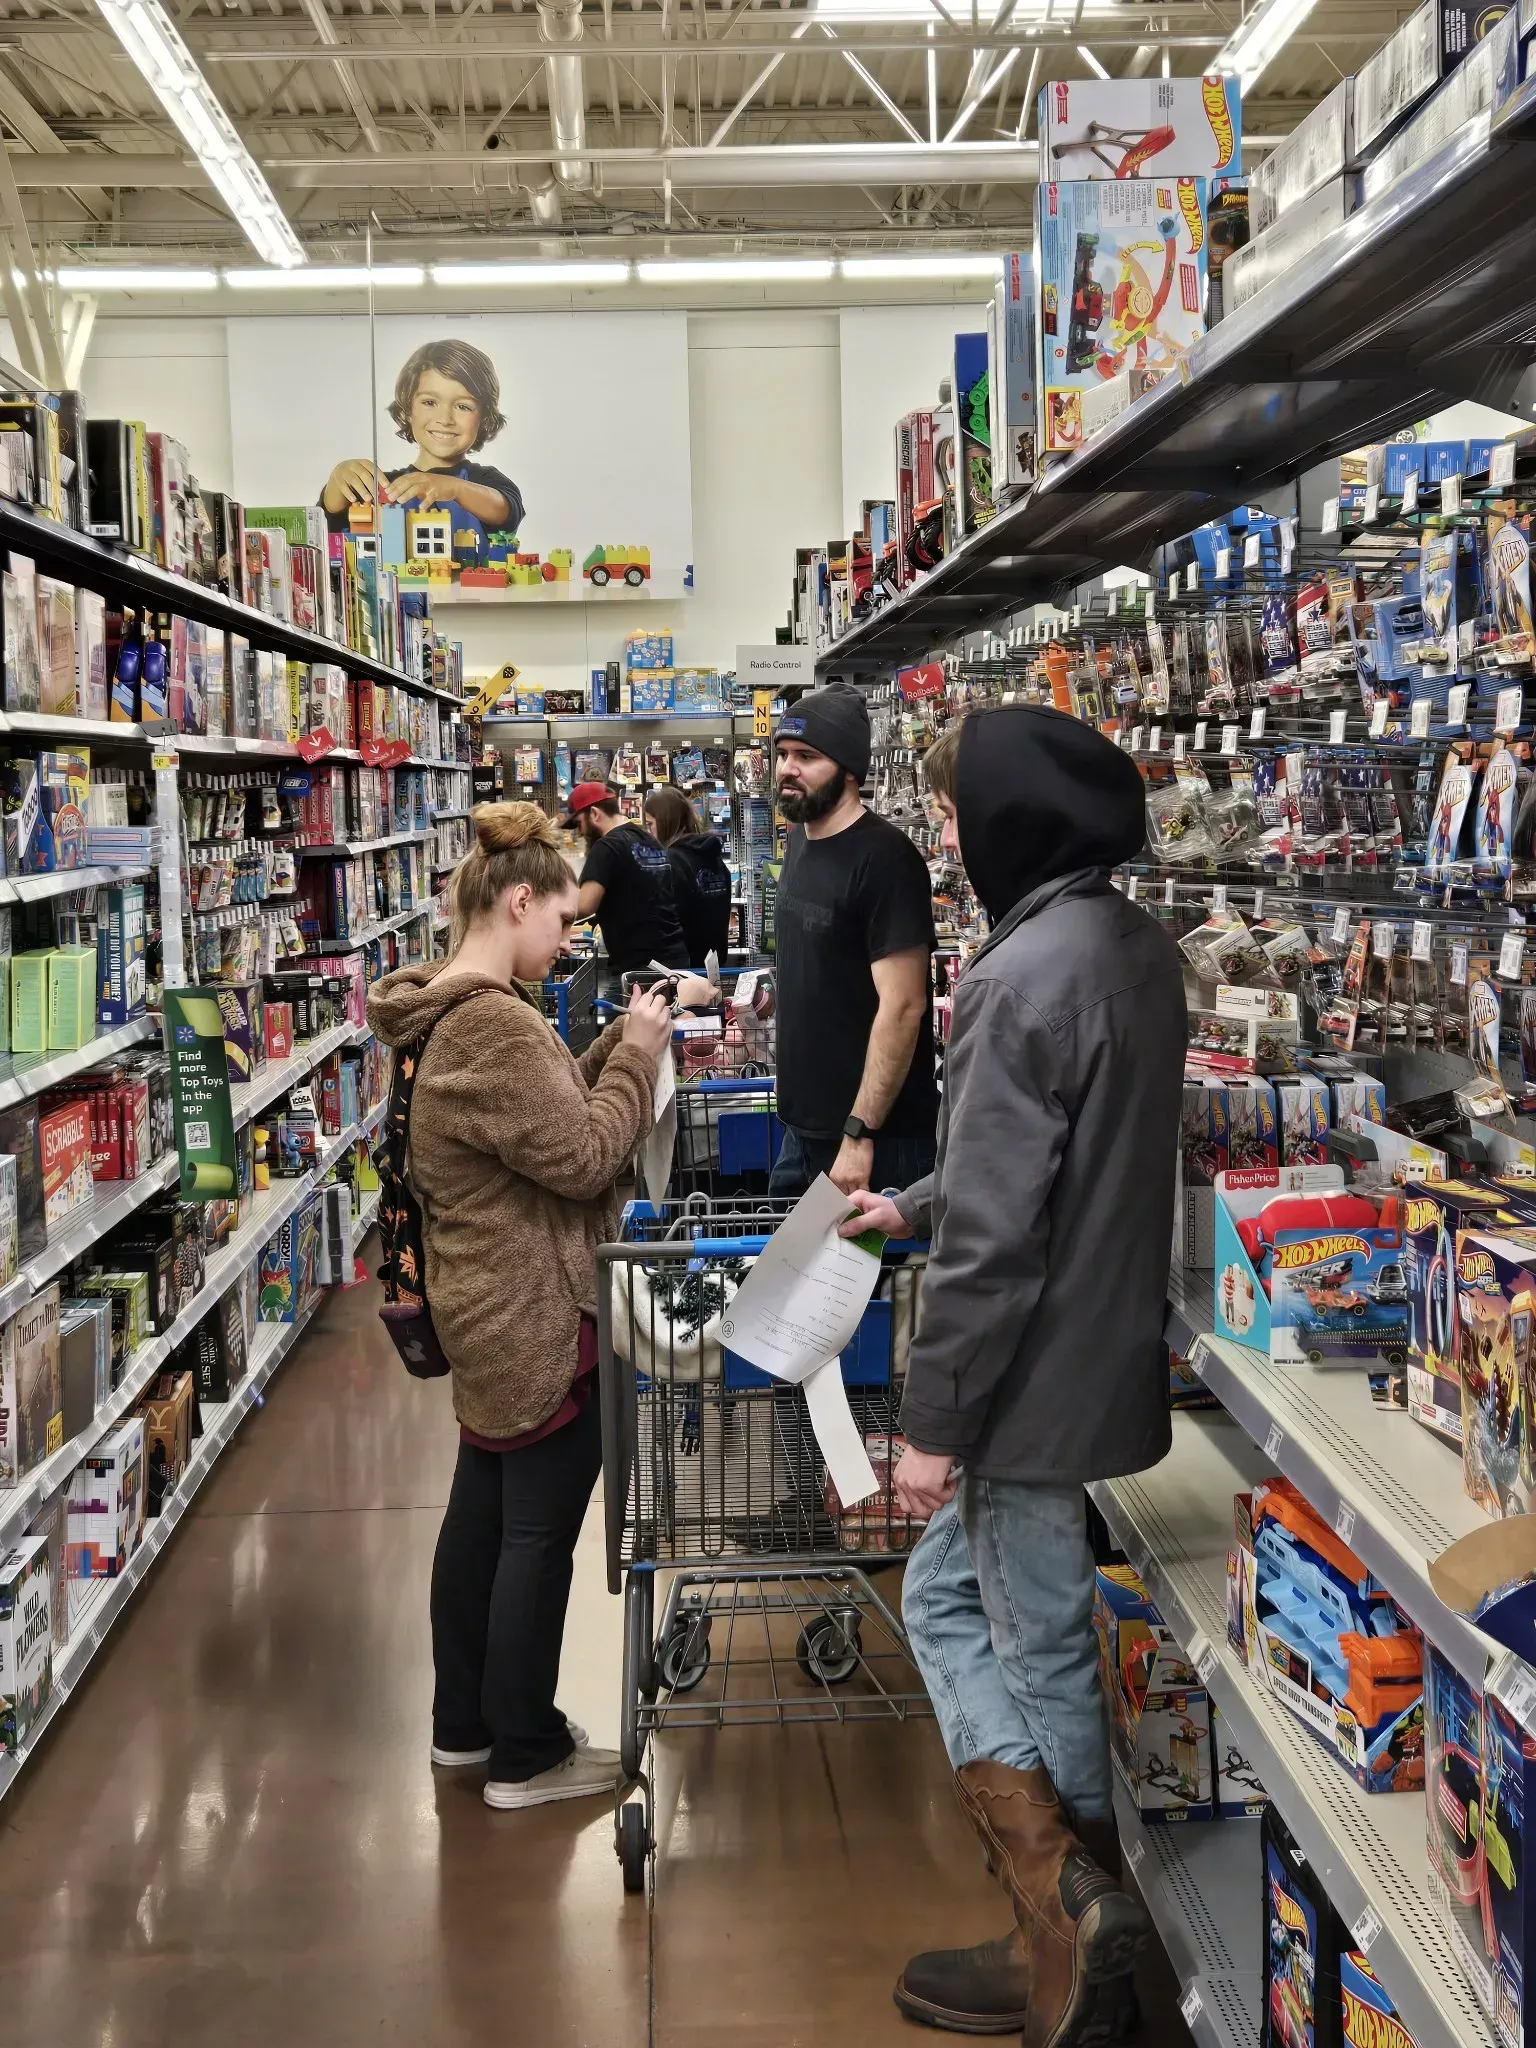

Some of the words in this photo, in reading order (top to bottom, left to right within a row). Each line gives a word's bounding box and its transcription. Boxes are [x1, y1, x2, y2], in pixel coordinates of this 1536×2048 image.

[902, 429, 910, 466] NASCAR
[750, 660, 772, 669] Radio
[773, 660, 802, 669] Control
[478, 691, 492, 707] N
[906, 685, 940, 700] Rollback
[757, 706, 767, 718] N
[756, 722, 767, 734] 10
[109, 911, 120, 938] WHAT
[110, 940, 120, 951] DO
[110, 952, 121, 972] YOU
[111, 972, 122, 1002] MEME?
[178, 1050, 201, 1061] Find
[179, 1064, 207, 1072] more
[180, 1077, 200, 1089] Top
[201, 1076, 224, 1088] Toys
[182, 1091, 192, 1101] in
[194, 1090, 212, 1100] the
[183, 1105, 203, 1115] app
[46, 1115, 84, 1157] SCRABBLE
[280, 1216, 292, 1262] SORRY!
[1294, 1260, 1346, 1280] SUPER
[18, 1315, 39, 1347] TICKET
[45, 1302, 57, 1328] RIDE
[201, 1365, 212, 1387] SET
[24, 1591, 39, 1625] WILD
[16, 1600, 48, 1672] FLOWERS
[1273, 1676, 1287, 1695] SPEED
[1288, 1687, 1301, 1704] DROP
[1301, 1697, 1331, 1728] TRANSPORT
